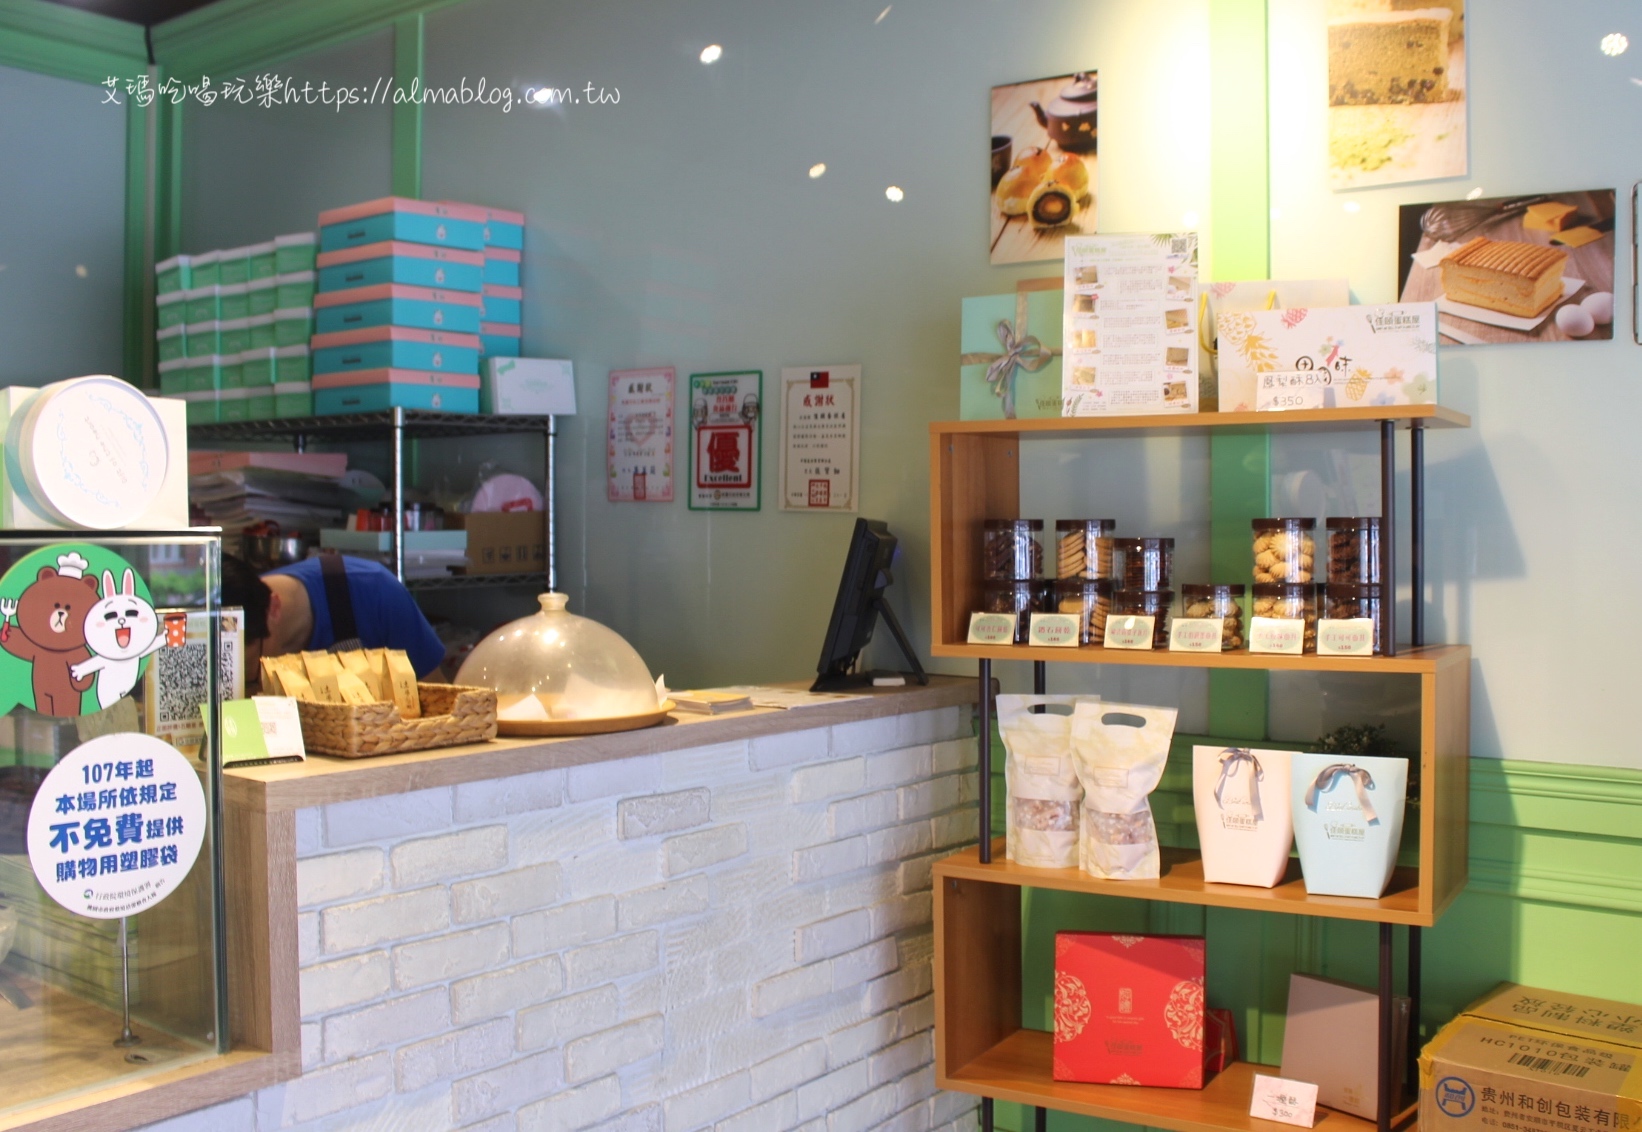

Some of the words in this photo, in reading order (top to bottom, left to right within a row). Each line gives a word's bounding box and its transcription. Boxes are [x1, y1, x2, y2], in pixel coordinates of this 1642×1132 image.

[803, 394, 835, 408] 感謝狀
[1272, 395, 1304, 406] $350
[707, 431, 740, 473] 優
[704, 473, 742, 482] Excellent
[82, 758, 155, 784] 107年起
[55, 782, 177, 815] 本場所依規定
[49, 812, 184, 853] 不免費提供
[56, 844, 178, 883] 購物用塑膠袋
[1519, 996, 1642, 1026] 小心轻放
[1479, 1036, 1633, 1073] HC1010包装罐
[1508, 1034, 1614, 1060] PET环保食品级
[1272, 1107, 1293, 1118] $300
